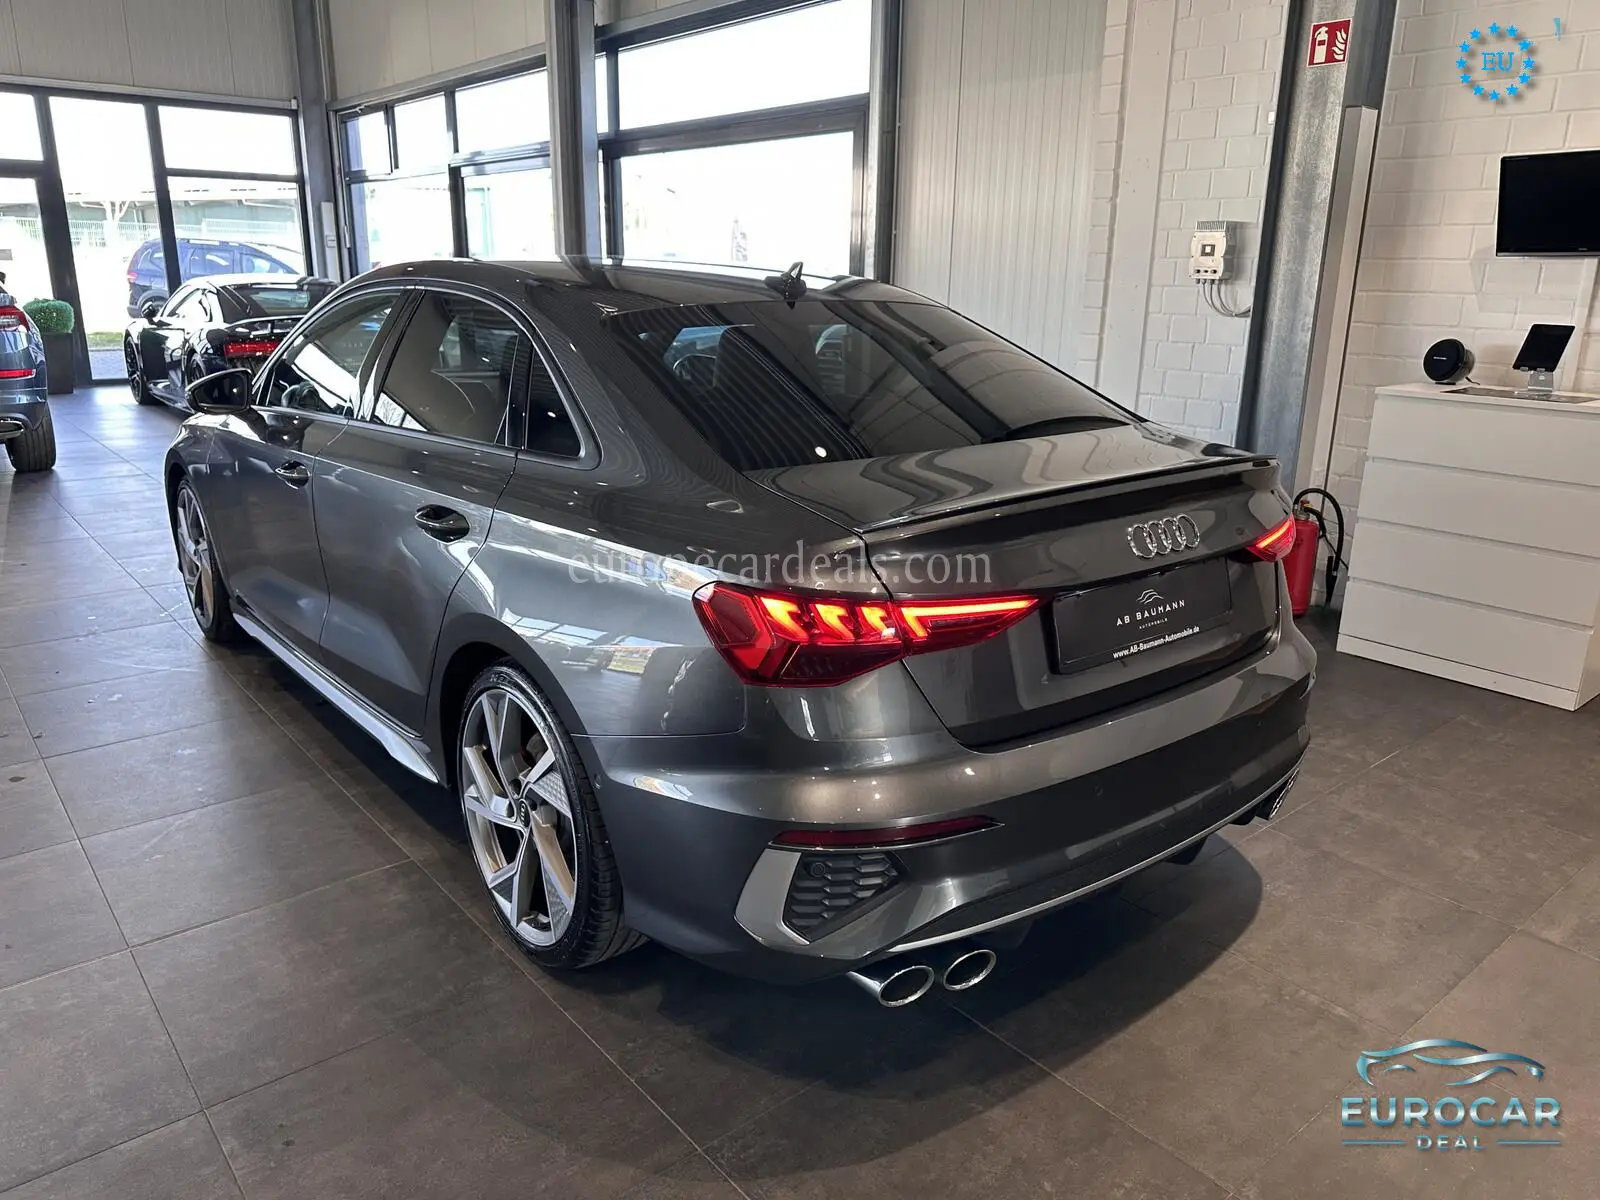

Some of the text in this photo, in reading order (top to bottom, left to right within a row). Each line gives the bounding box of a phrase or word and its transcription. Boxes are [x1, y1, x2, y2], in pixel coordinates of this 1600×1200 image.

[1116, 600, 1185, 626] AB BAUMANN
[1112, 626, 1200, 658] www.AB-Baumann-Automobile.de
